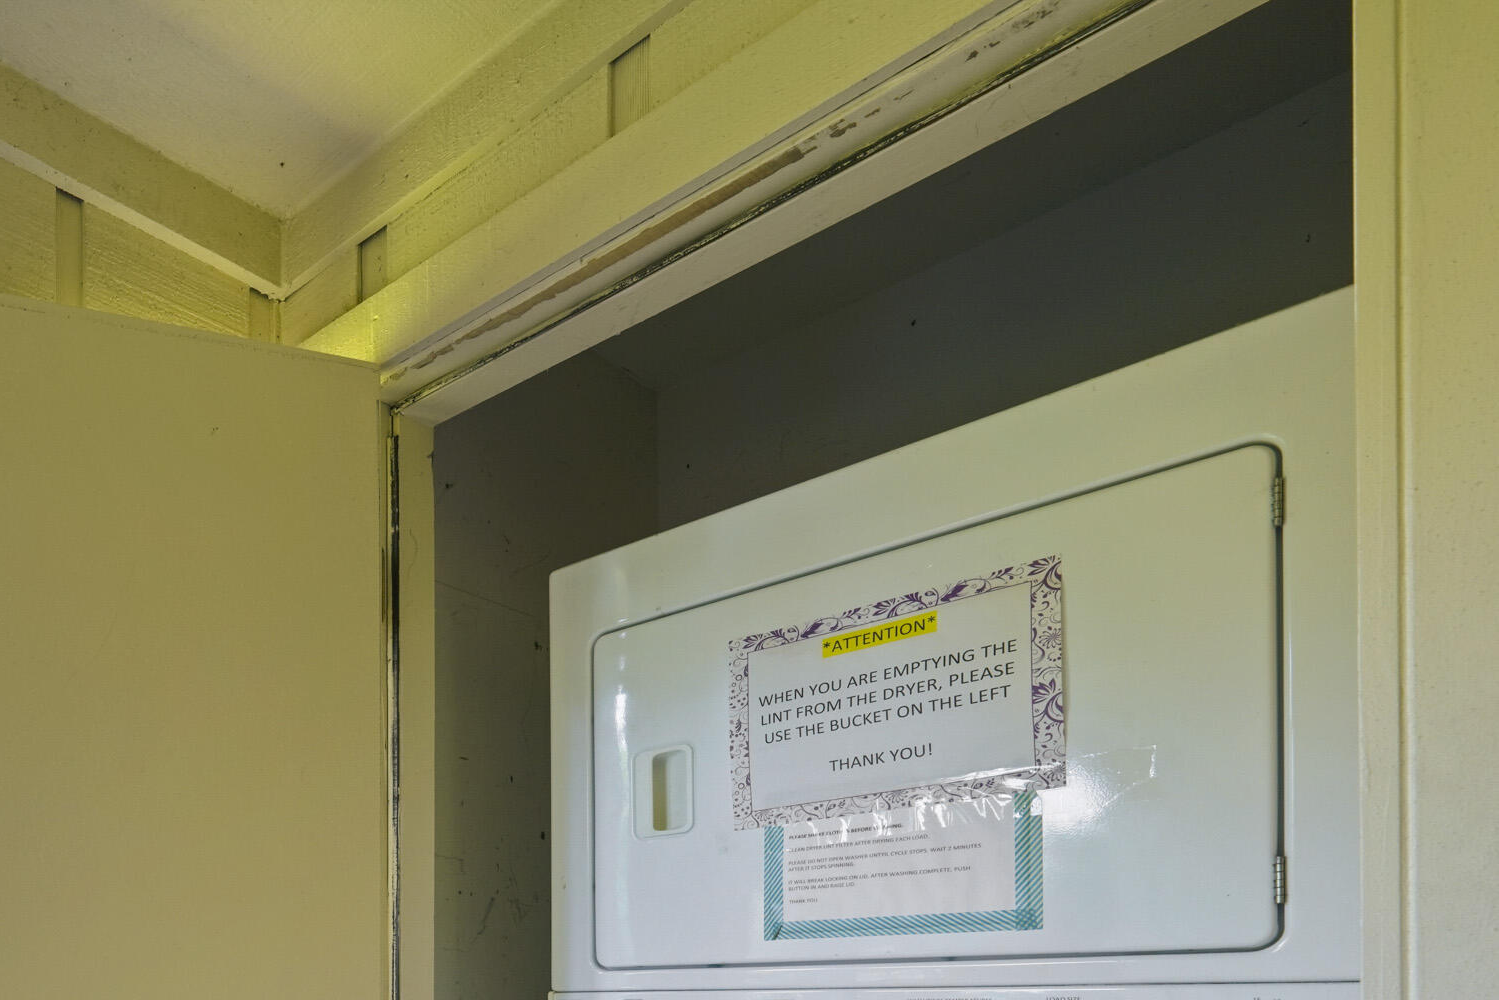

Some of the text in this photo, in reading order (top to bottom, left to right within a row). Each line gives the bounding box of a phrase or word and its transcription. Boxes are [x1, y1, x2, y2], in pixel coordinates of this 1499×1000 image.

[759, 639, 1018, 707] WHEN YOU ARE EMPTYING THE
[761, 661, 1015, 726] LINT FROM THE DRYER, PLEASE
[765, 684, 1011, 744] USE THE BUCKET ON THE LEFT
[829, 742, 932, 771] THANK YOU!
[953, 842, 982, 851] MINUTES
[889, 868, 918, 877] WASHING
[954, 864, 971, 872] PUSH
